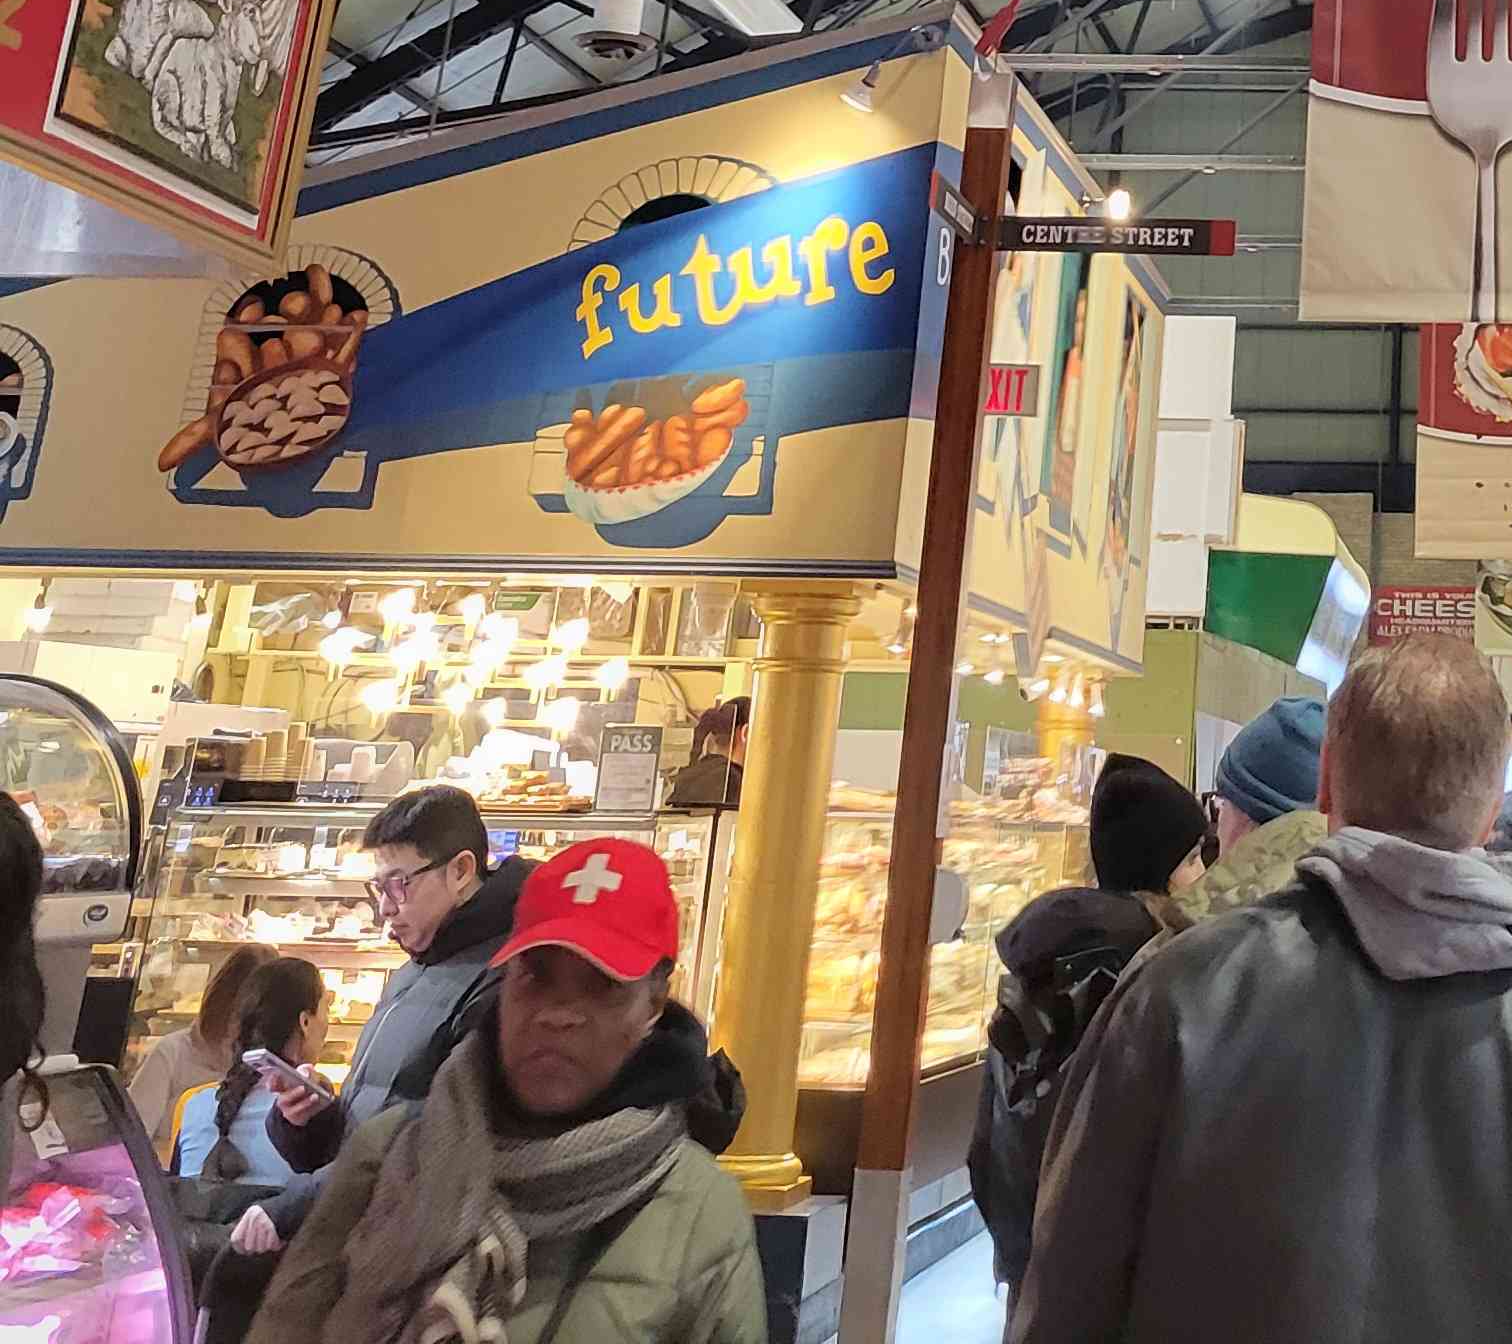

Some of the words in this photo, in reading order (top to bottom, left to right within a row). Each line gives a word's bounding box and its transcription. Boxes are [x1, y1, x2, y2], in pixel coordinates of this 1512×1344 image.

[1111, 226, 1194, 248] STREET
[575, 214, 896, 360] future
[610, 734, 653, 752] PASS
